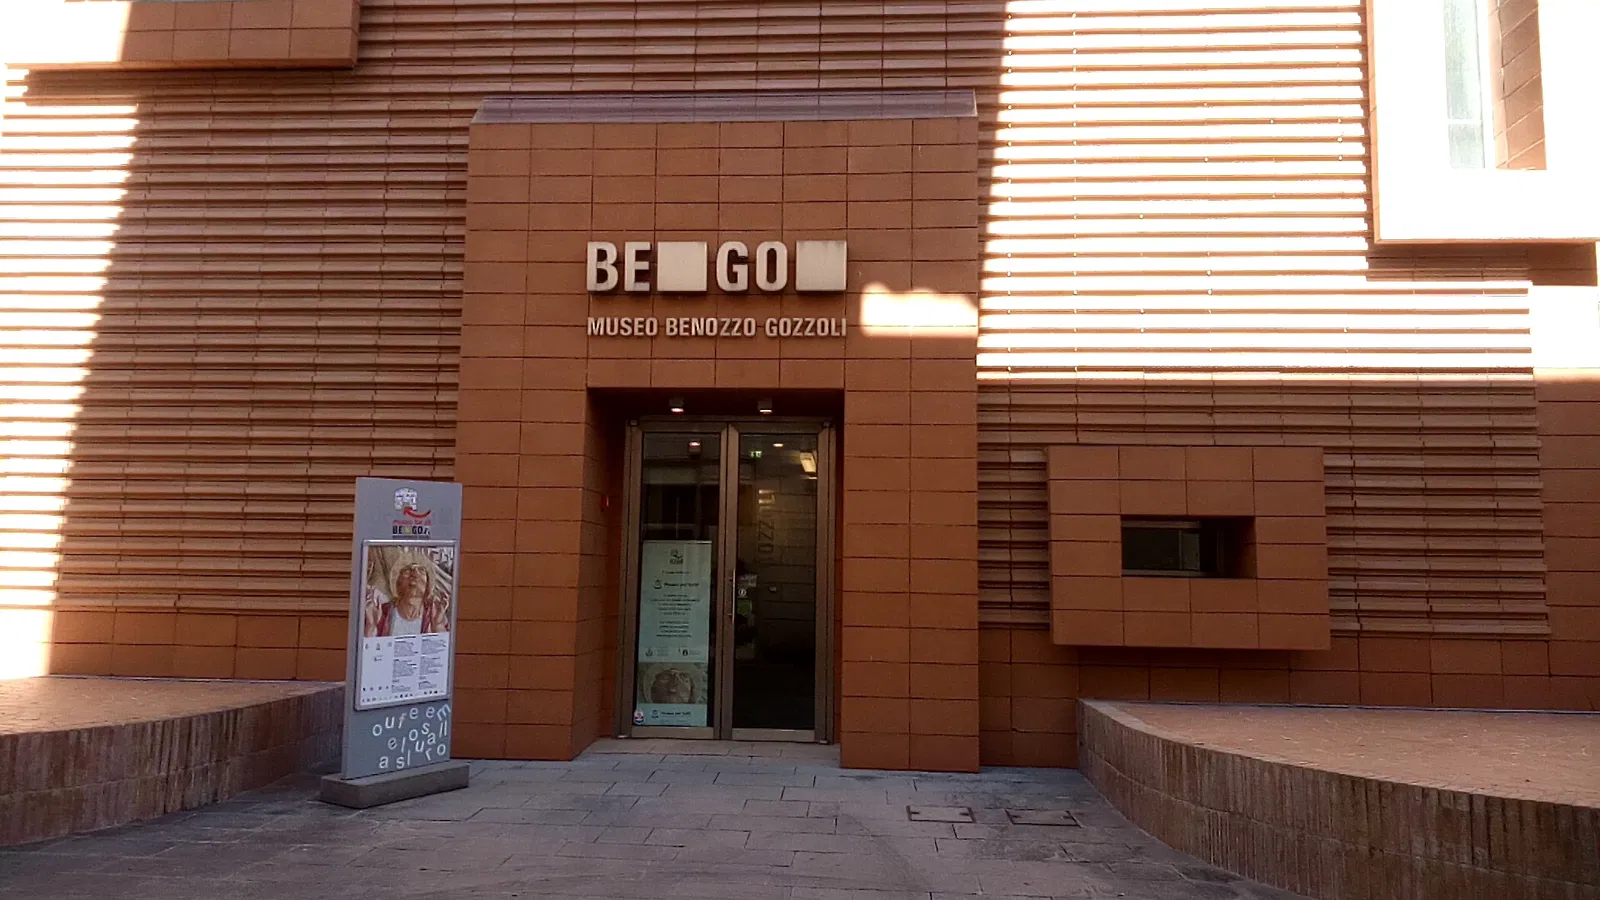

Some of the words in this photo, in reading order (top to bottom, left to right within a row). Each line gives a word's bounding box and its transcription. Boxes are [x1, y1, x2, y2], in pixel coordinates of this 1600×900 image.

[587, 241, 651, 292] BE
[716, 241, 788, 292] GO
[587, 317, 658, 336] MUSEO
[665, 317, 756, 336] BENOZZO
[765, 317, 847, 336] GOZZOLI
